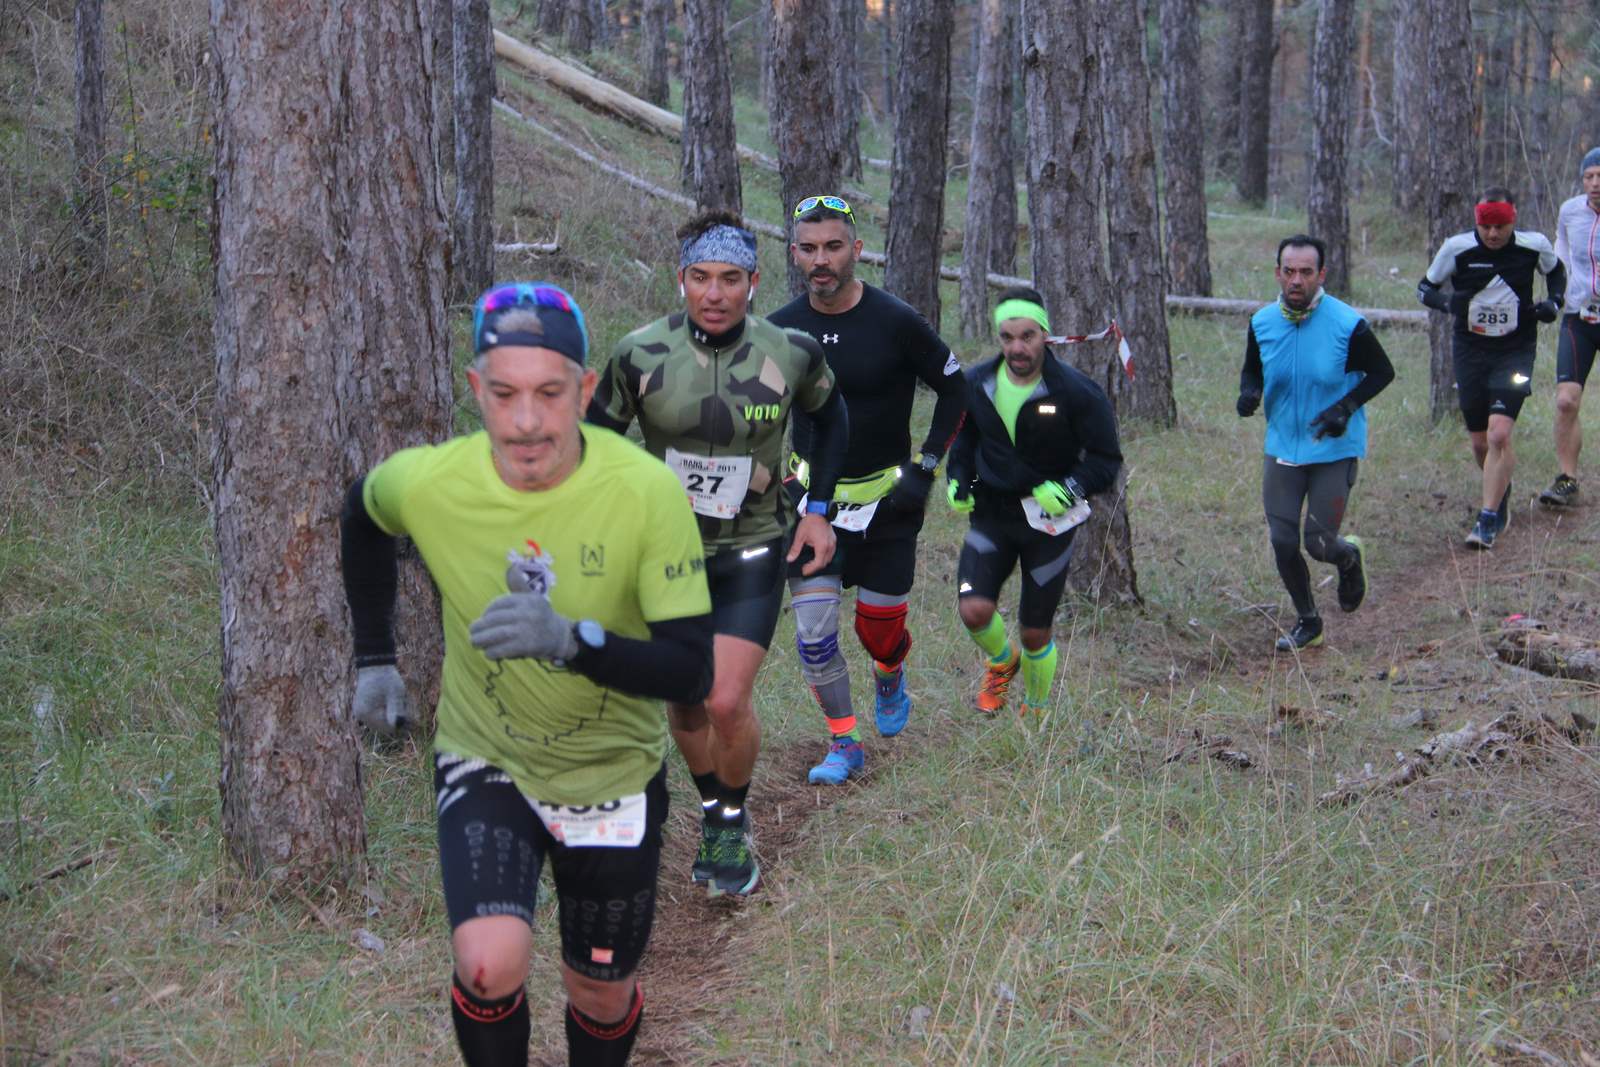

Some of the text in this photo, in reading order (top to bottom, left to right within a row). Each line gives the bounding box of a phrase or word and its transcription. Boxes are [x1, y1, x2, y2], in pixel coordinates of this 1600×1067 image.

[1477, 312, 1508, 324] 283
[744, 404, 780, 421] VOID
[687, 474, 724, 495] 27
